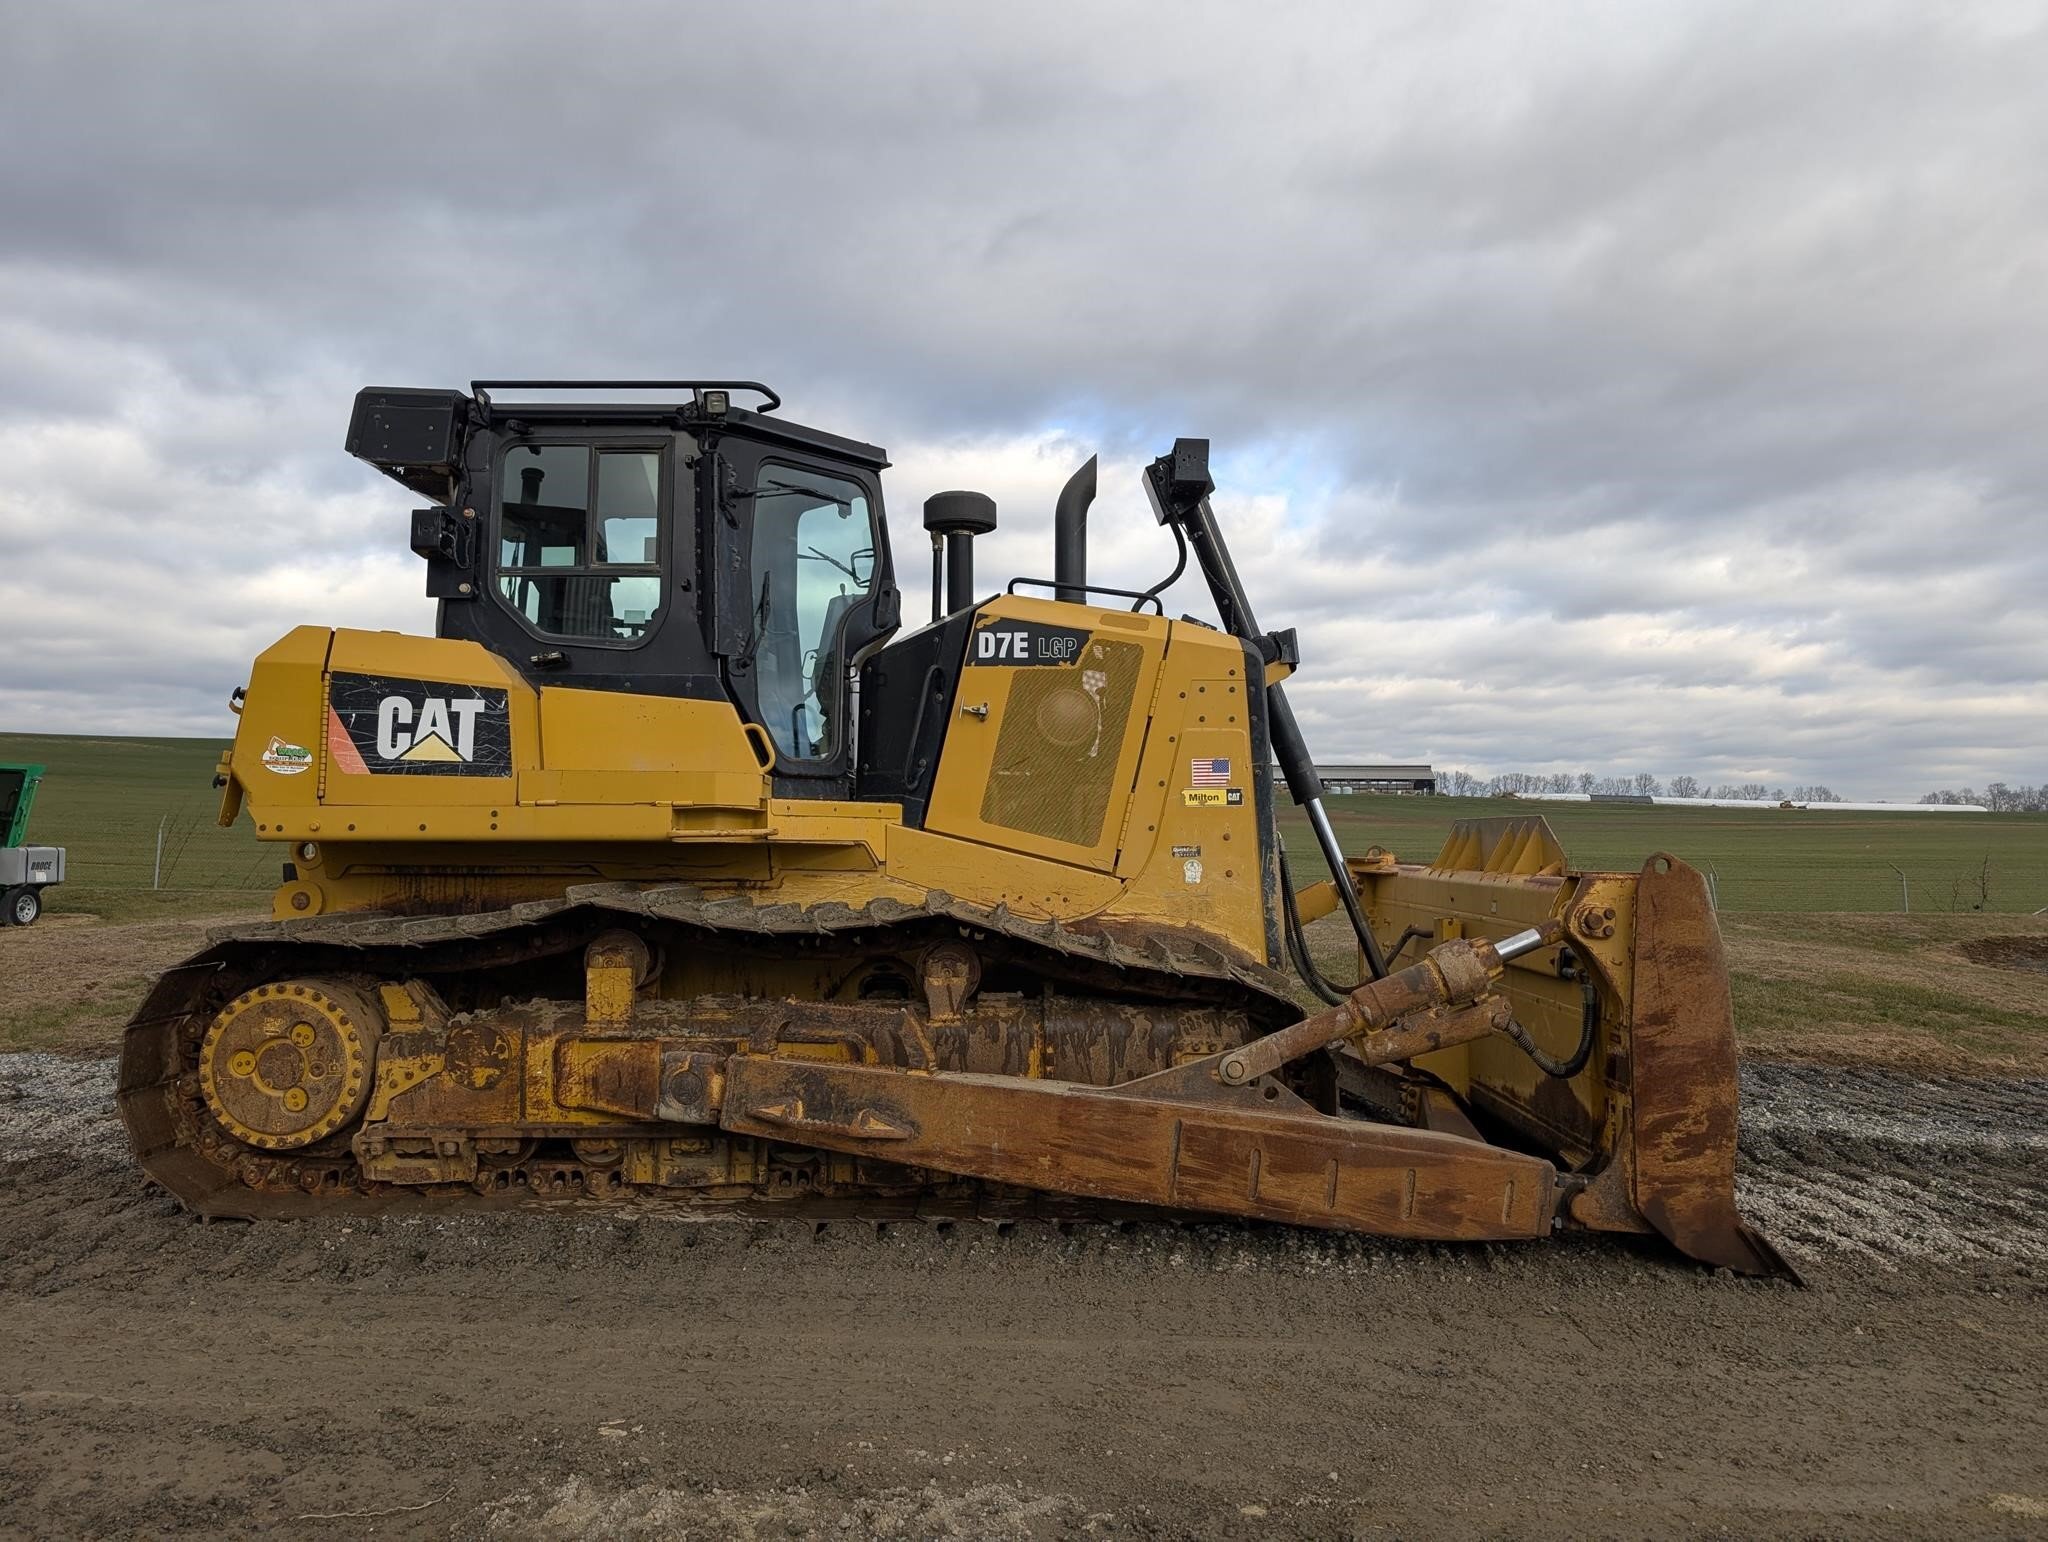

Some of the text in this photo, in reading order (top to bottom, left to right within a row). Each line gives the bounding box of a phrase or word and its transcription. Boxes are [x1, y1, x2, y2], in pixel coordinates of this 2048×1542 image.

[978, 631, 1077, 658] D7E LGP
[377, 695, 485, 761] CAT
[1188, 792, 1241, 801] Milton CAT
